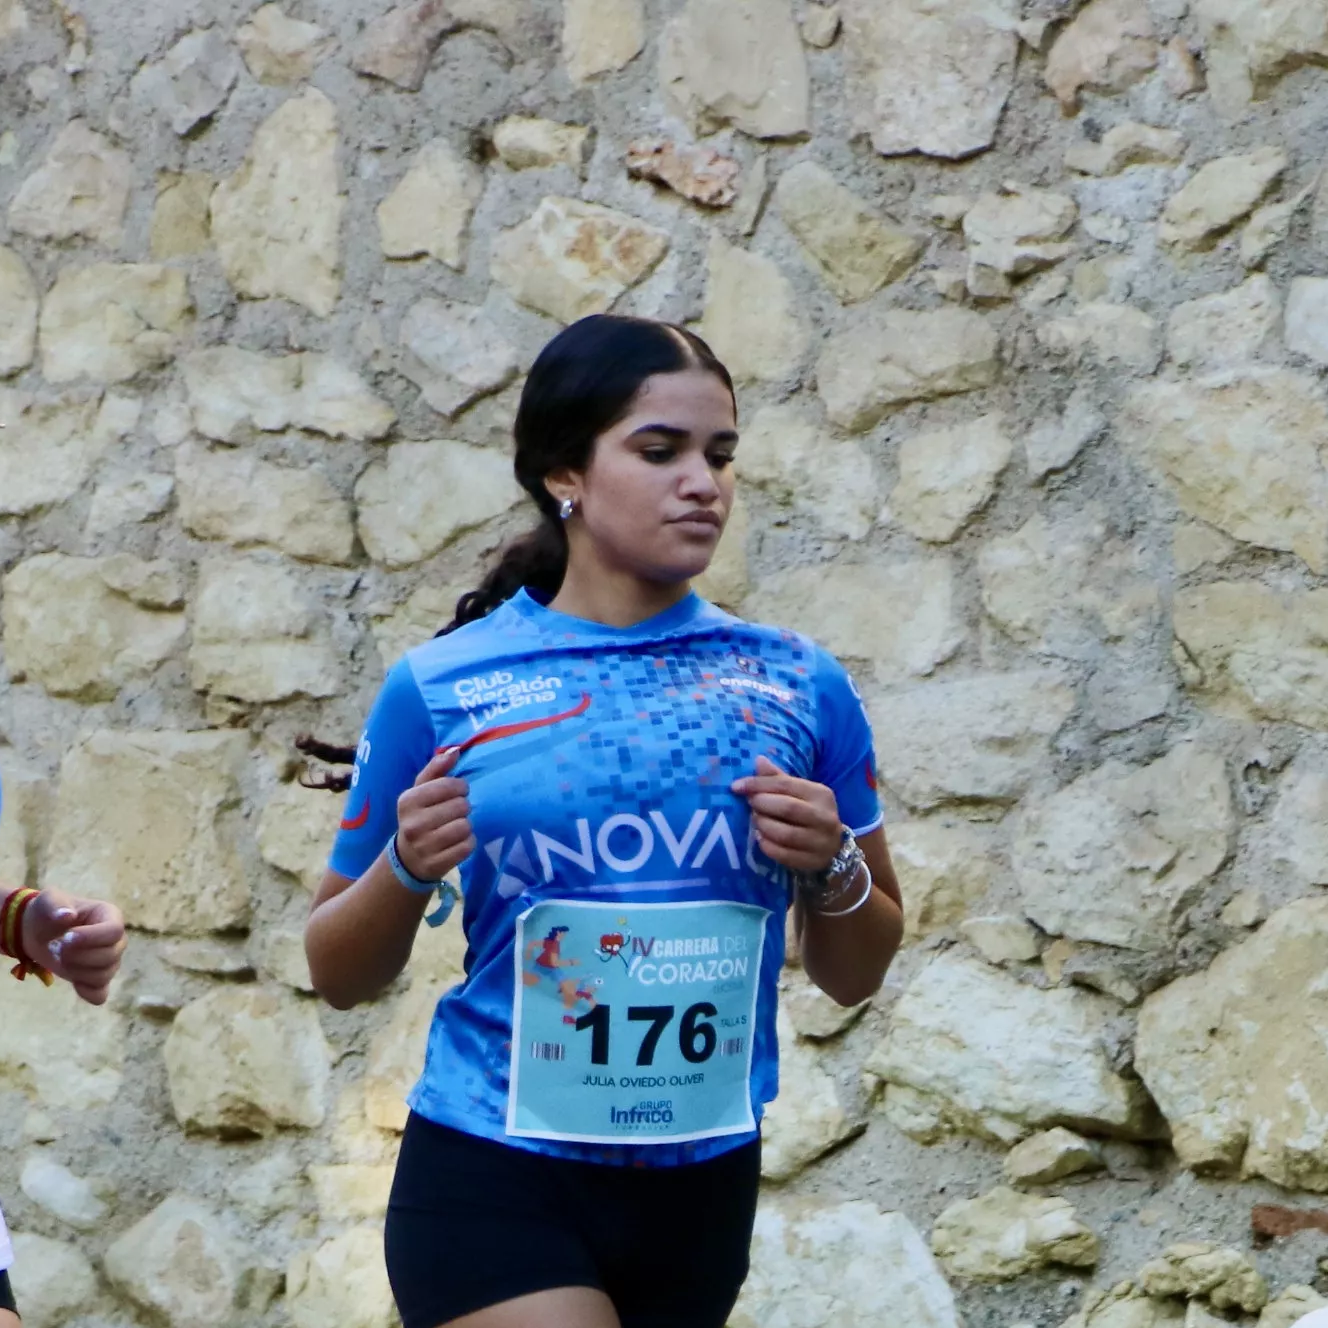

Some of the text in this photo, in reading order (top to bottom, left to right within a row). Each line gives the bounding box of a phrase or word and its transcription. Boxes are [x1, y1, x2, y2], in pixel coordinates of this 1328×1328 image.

[454, 671, 513, 697] Club
[468, 691, 556, 731] Lucena
[632, 935, 748, 958] IV CARRERA DEL
[576, 1002, 718, 1066] 176
[582, 1073, 705, 1088] JULIA OVIEDO OLIVER
[610, 1106, 673, 1124] Infrico
[640, 1100, 672, 1110] GRUPO
